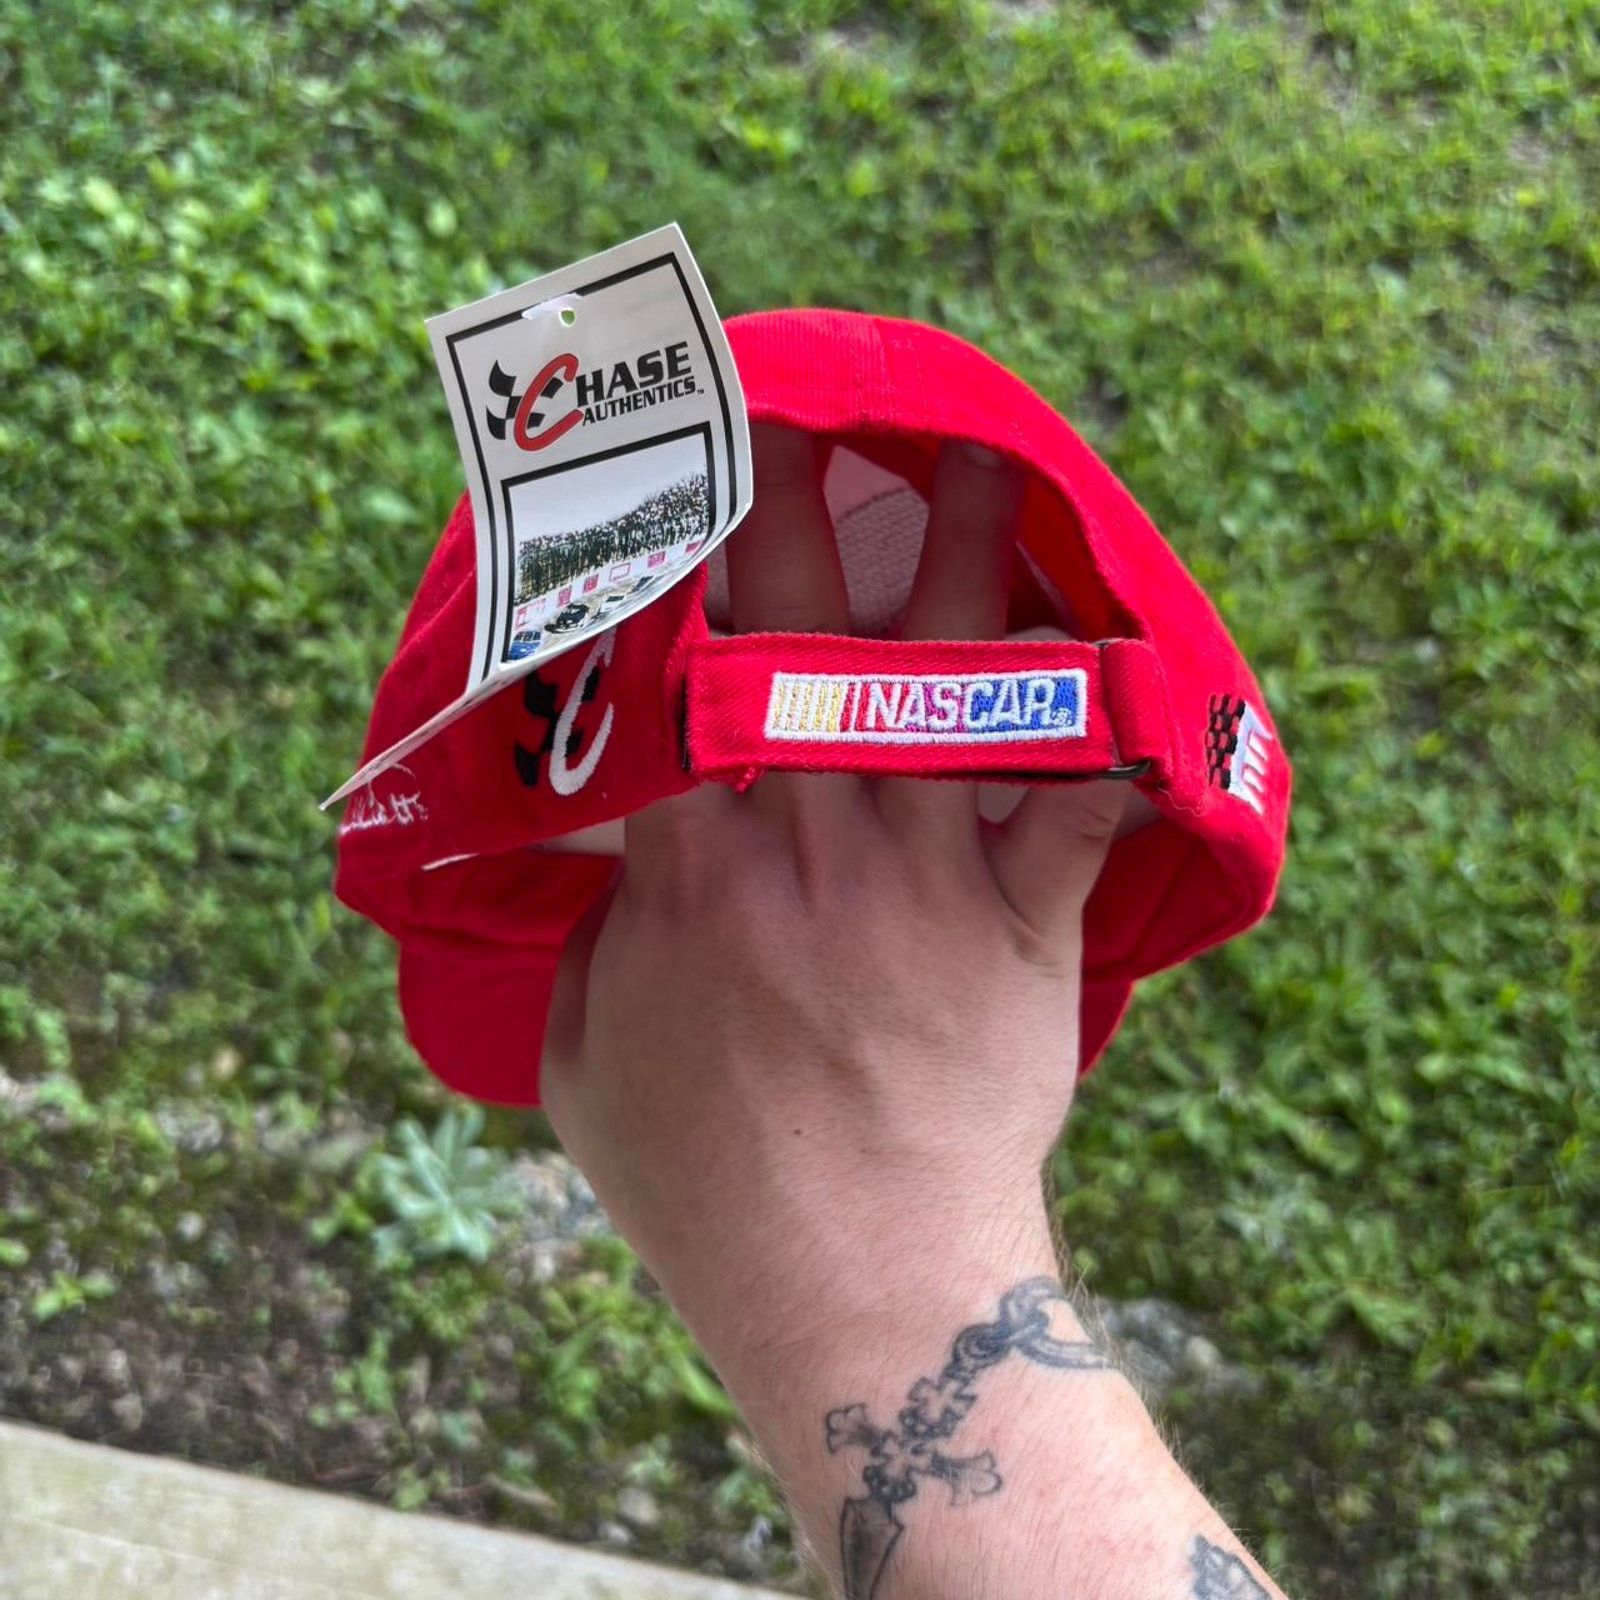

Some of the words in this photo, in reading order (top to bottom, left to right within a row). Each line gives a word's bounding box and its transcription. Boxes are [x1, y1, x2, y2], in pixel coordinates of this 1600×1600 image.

[513, 341, 692, 452] CHASE
[582, 375, 696, 427] AUTHENTICS
[865, 677, 1056, 730] NASCAR
